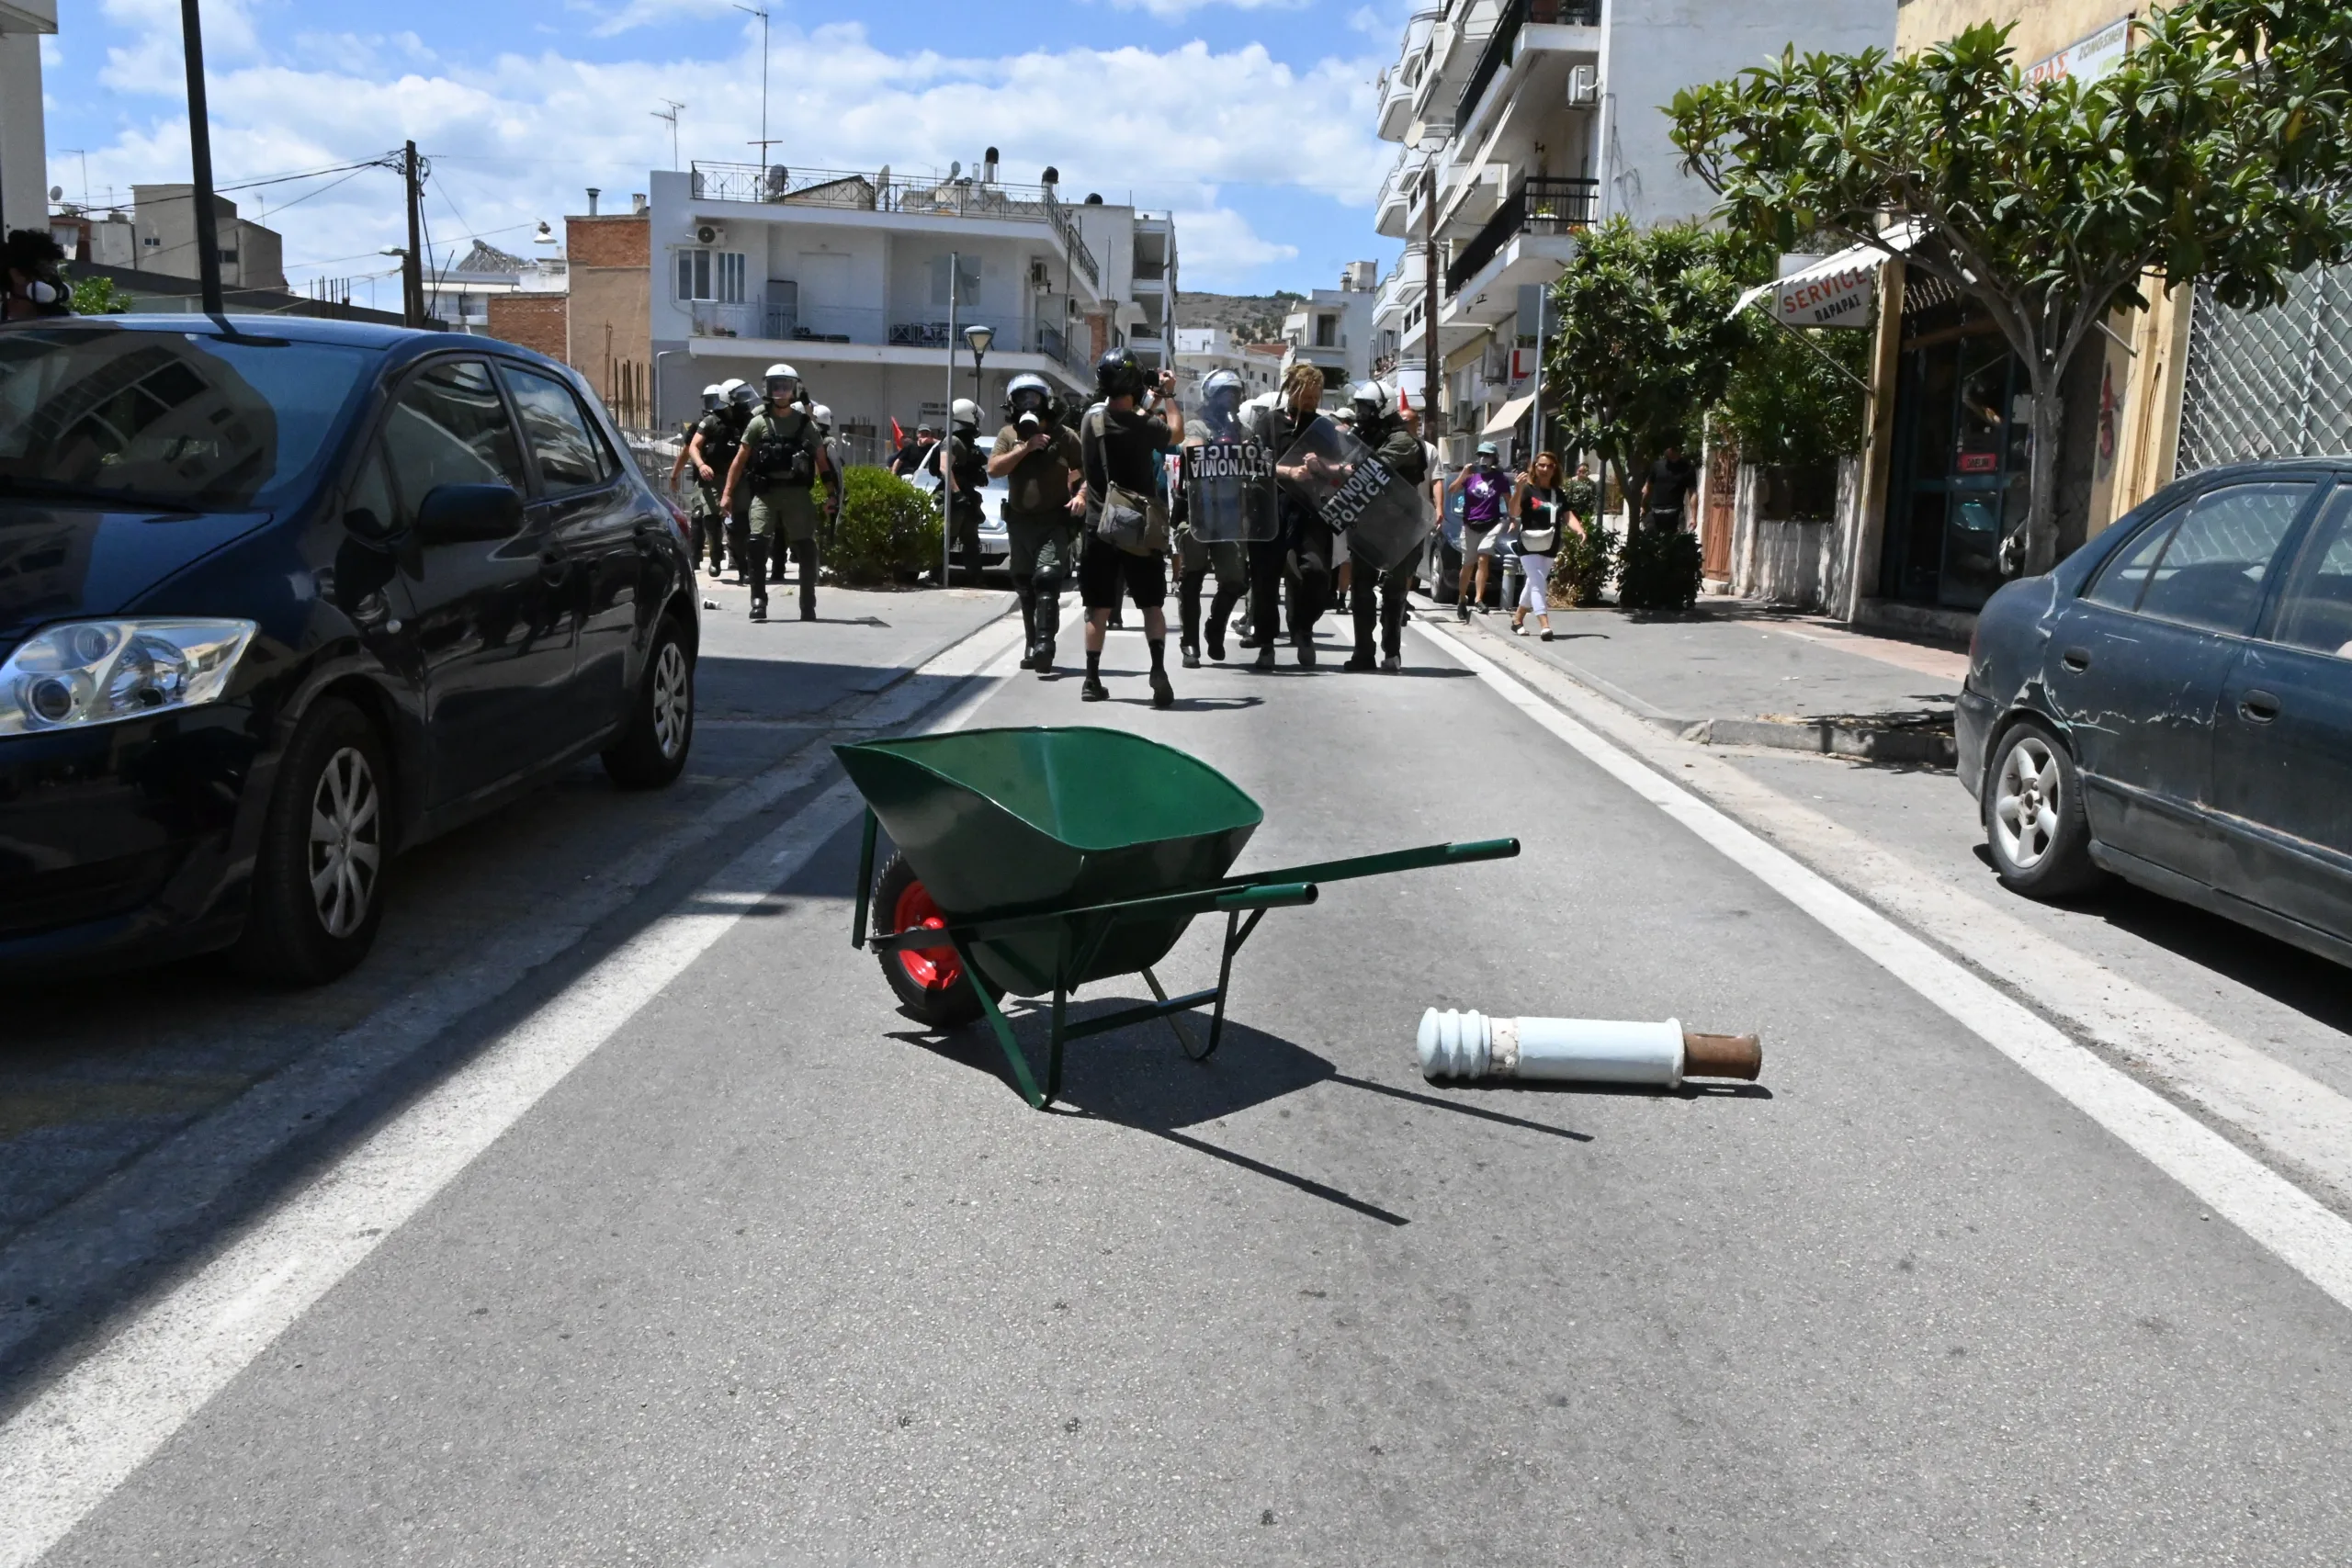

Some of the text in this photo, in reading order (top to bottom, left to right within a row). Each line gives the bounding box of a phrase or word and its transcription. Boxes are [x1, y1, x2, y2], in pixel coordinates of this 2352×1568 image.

[1783, 266, 1867, 314] SERVICE
[1815, 294, 1861, 322] ΠΑΡΑΡΑΣ
[1191, 458, 1273, 478] ΑΣΤΥΝΟΜΙΑ
[1317, 457, 1384, 525] ΑΣΤΥΝΟΜΙΑ
[1331, 469, 1391, 532] POLICE
